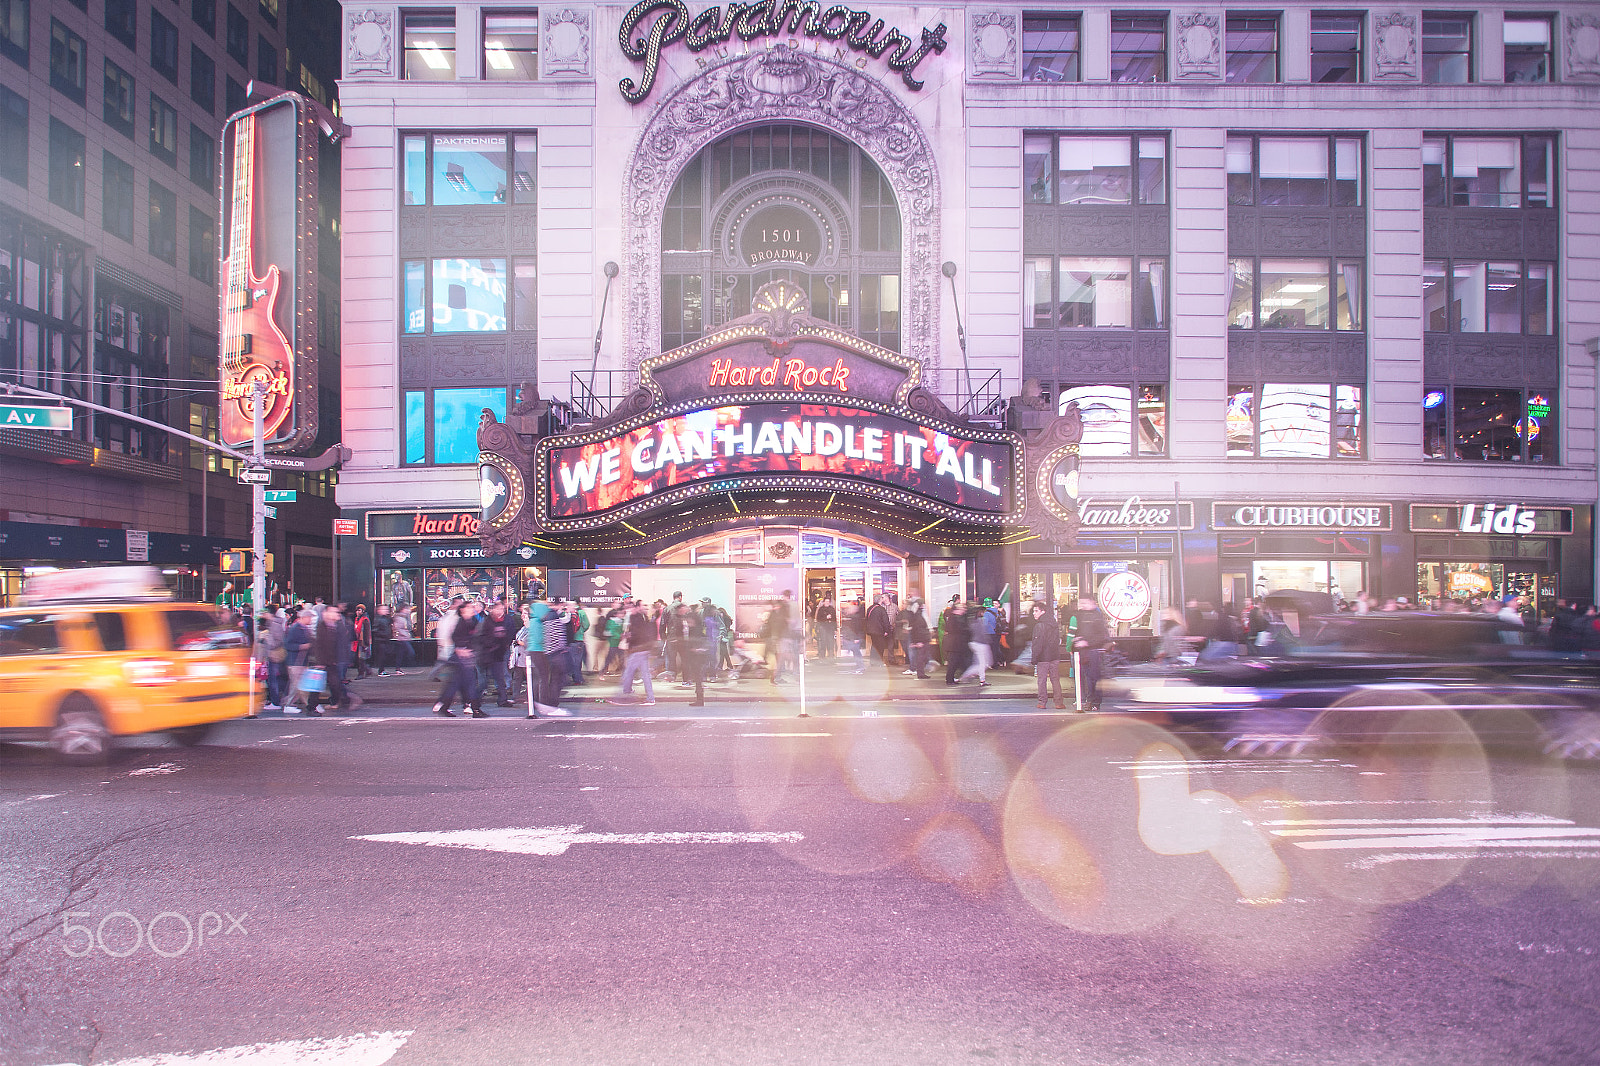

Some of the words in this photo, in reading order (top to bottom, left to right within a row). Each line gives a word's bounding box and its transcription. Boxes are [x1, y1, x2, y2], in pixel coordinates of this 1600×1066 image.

[619, 0, 948, 103] Paramount
[694, 37, 868, 70] BUILDING
[762, 229, 801, 243] 1501
[750, 249, 812, 263] BROADWAY
[709, 357, 781, 387] Hard
[783, 357, 851, 392] Rock
[6, 409, 36, 424] Av
[265, 458, 305, 467] ECTACOLOR
[560, 447, 620, 498] WE
[631, 430, 718, 473] CAN
[724, 421, 883, 462] HANDLE
[894, 433, 927, 469] IT
[935, 446, 1000, 496] ALL
[272, 491, 279, 501] 7
[1077, 495, 1171, 525] Yankees
[1235, 506, 1381, 526] CLUBHOUSE
[1461, 503, 1536, 534] Lids
[412, 513, 457, 534] Hard
[458, 513, 481, 537] Ro
[430, 550, 462, 558] ROCK
[463, 549, 486, 558] SHO
